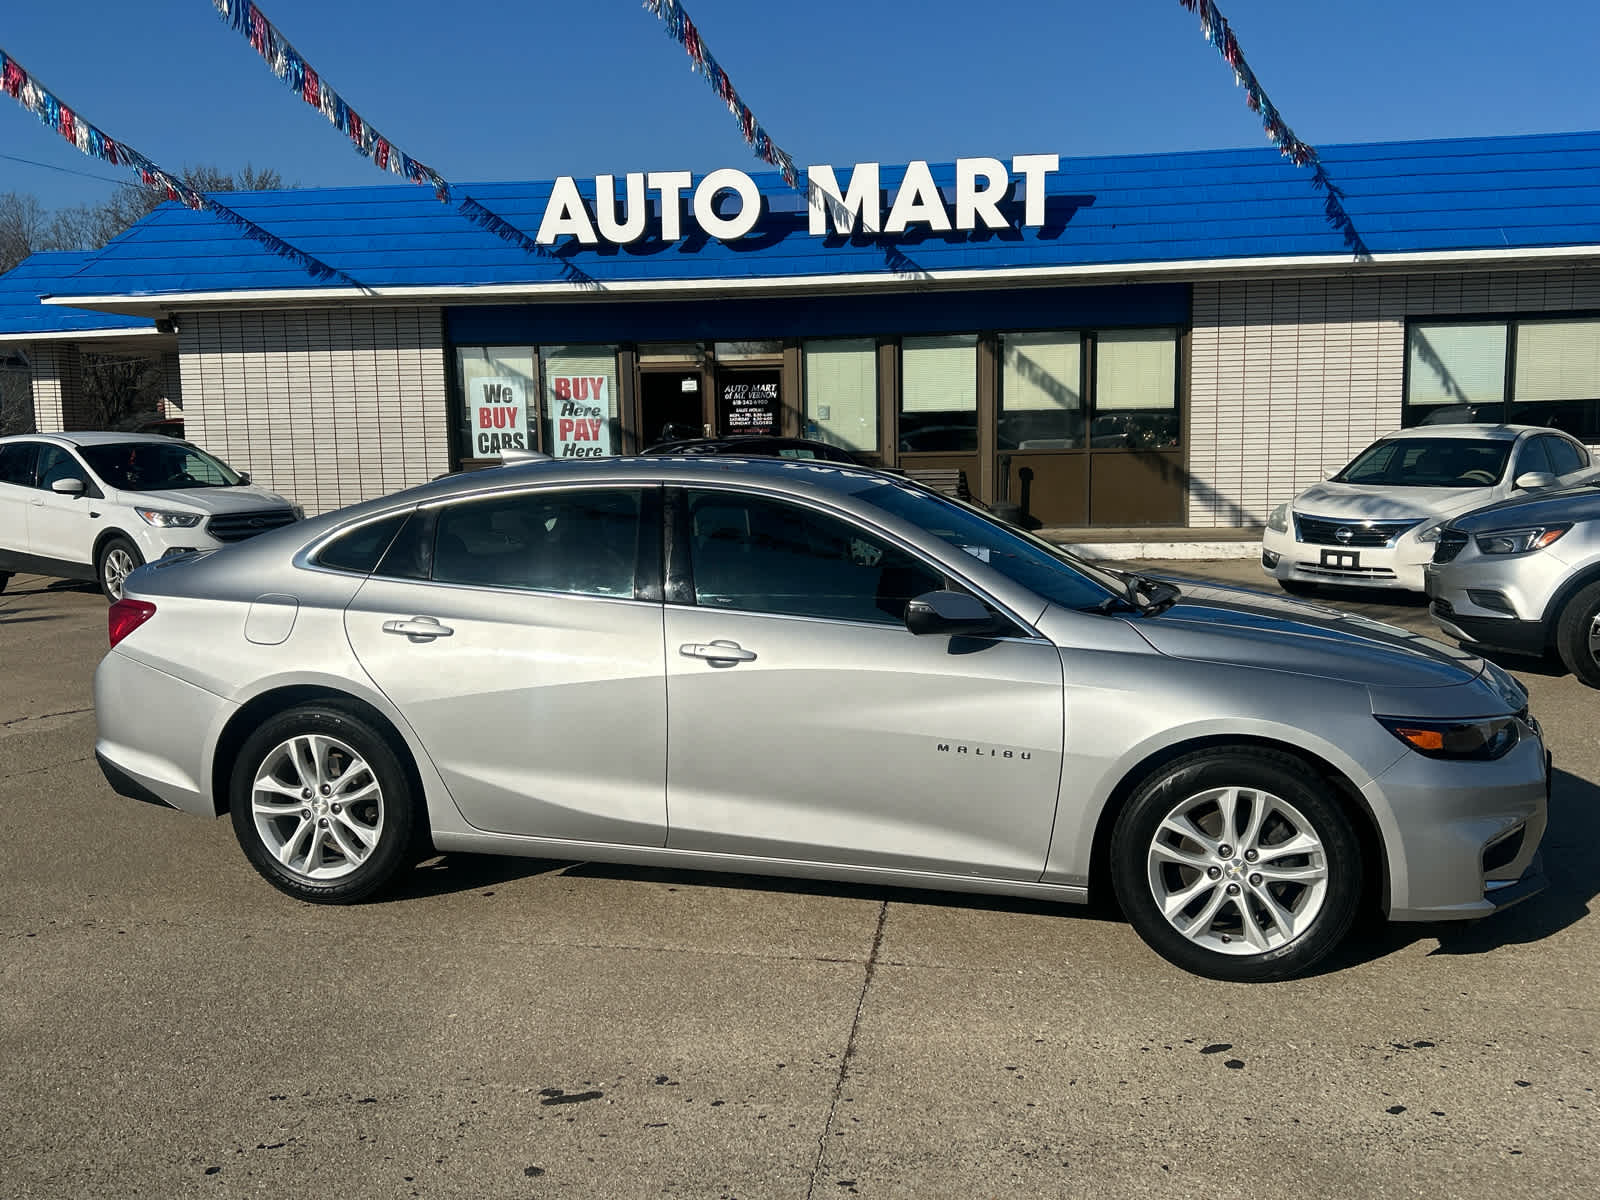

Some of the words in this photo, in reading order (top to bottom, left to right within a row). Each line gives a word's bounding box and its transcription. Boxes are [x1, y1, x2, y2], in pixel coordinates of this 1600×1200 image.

[535, 168, 762, 245] AUTO
[807, 154, 1059, 235] MART
[483, 384, 513, 403] We
[555, 377, 603, 400] BUY
[724, 384, 749, 392] AUTO
[752, 383, 777, 391] MART
[724, 391, 733, 399] of
[479, 407, 517, 428] BUY
[561, 402, 600, 416] Here
[560, 419, 601, 441] PAY
[478, 432, 524, 454] CARS
[562, 443, 602, 457] Here
[937, 743, 1031, 760] MALIBU
